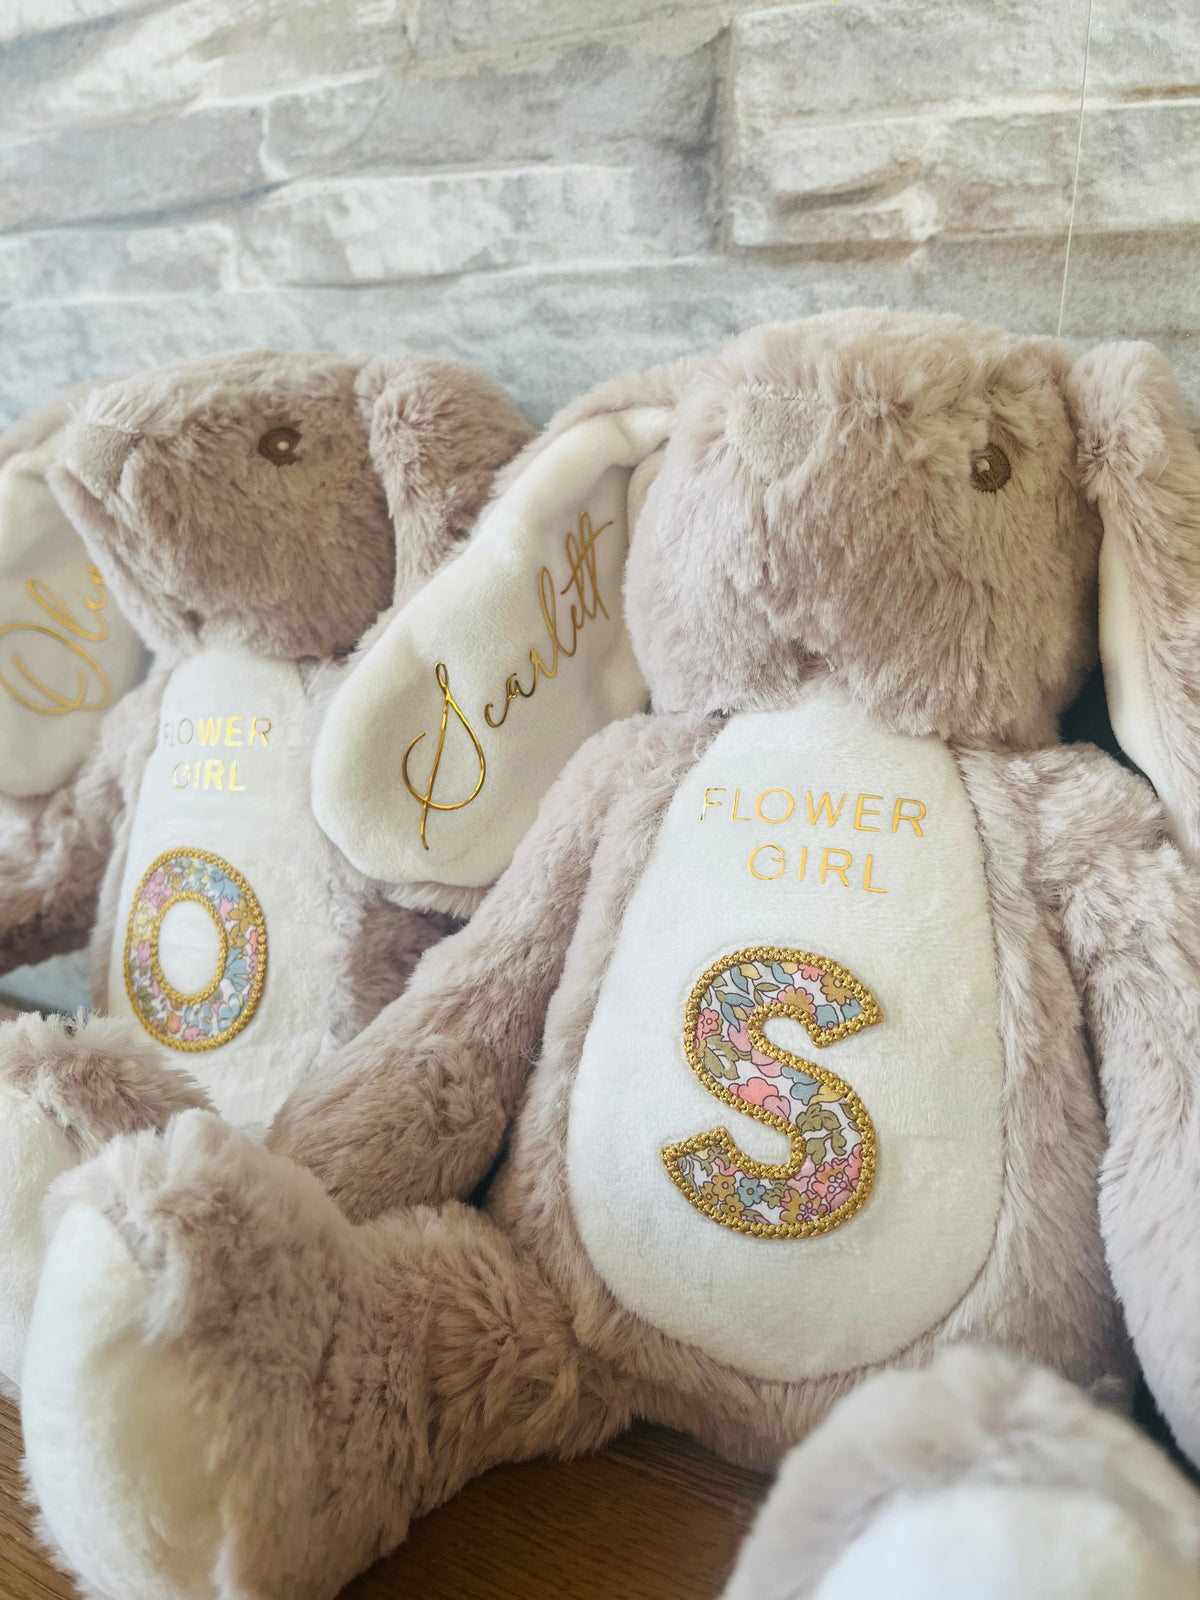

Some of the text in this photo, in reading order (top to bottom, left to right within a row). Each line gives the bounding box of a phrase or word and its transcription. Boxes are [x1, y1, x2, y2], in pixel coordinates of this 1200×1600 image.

[403, 509, 614, 851] Scarlett
[172, 759, 246, 791] GIRL
[699, 787, 927, 837] FLOWER
[748, 844, 888, 894] GIRL
[124, 846, 268, 1052] O
[660, 946, 883, 1240] S
